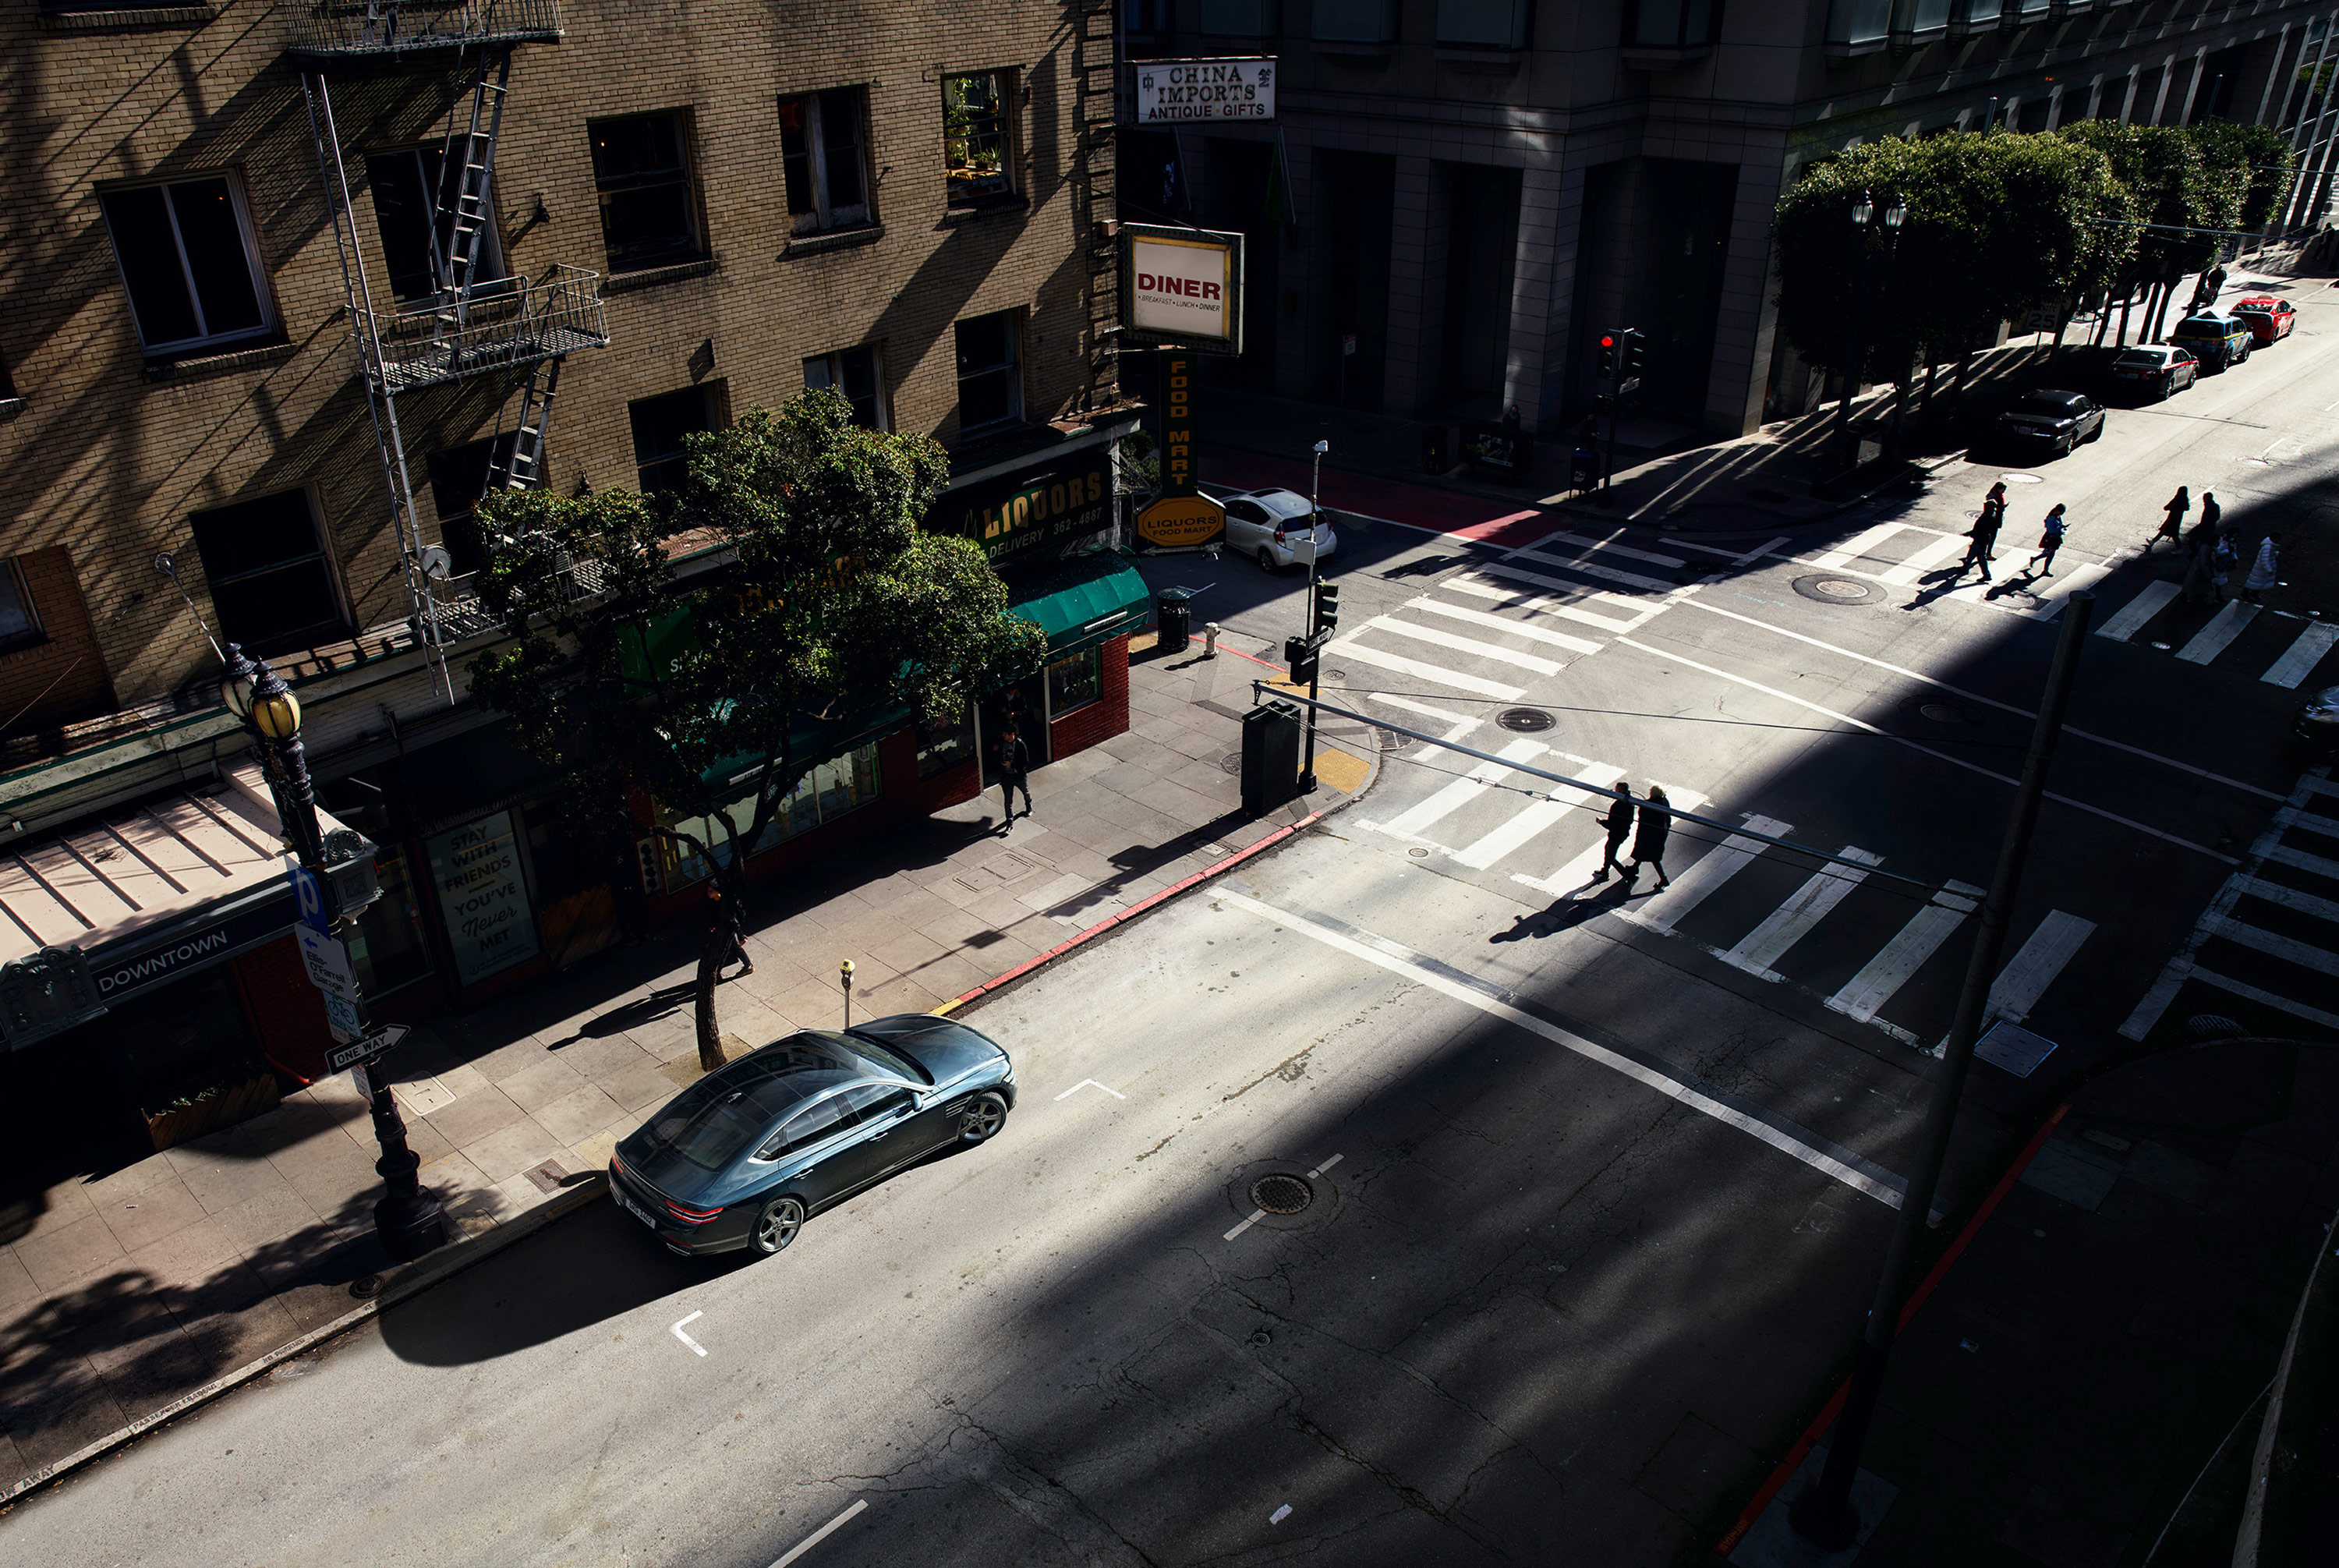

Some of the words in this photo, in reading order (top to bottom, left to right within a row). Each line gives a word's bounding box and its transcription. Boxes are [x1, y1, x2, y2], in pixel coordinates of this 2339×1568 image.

[1170, 65, 1243, 83] CHINA
[1158, 83, 1255, 103] IMPORTS
[1148, 105, 1212, 119] ANTIQUE
[1223, 103, 1265, 116] GIFTS
[1138, 273, 1221, 300] DINER
[1141, 295, 1173, 306] BREAKFAST
[1176, 299, 1195, 309] LUNCH
[1198, 303, 1221, 312] DINNER
[2029, 313, 2056, 329] 25
[1170, 361, 1188, 418] FOOD
[1168, 430, 1190, 486] MART
[982, 471, 1102, 540] LIQUORS
[1147, 516, 1218, 529] LIQUORS
[1152, 528, 1181, 537] FOOD
[1184, 526, 1212, 535] MART
[989, 528, 1045, 559] DELIVERY
[451, 826, 487, 850] STAY
[451, 841, 497, 868] WITH
[444, 855, 511, 893] FRIENDS
[454, 882, 517, 916] YOU'VE
[462, 906, 518, 938] Never
[479, 929, 510, 952] MET
[98, 930, 228, 993] DOWNTOWN
[306, 950, 327, 966] Ellis-
[310, 962, 345, 984] O'Farrell
[313, 972, 345, 993] Garage
[337, 1047, 359, 1064] ONE
[363, 1035, 385, 1052] WAY
[23, 1465, 55, 1488] AWAY
